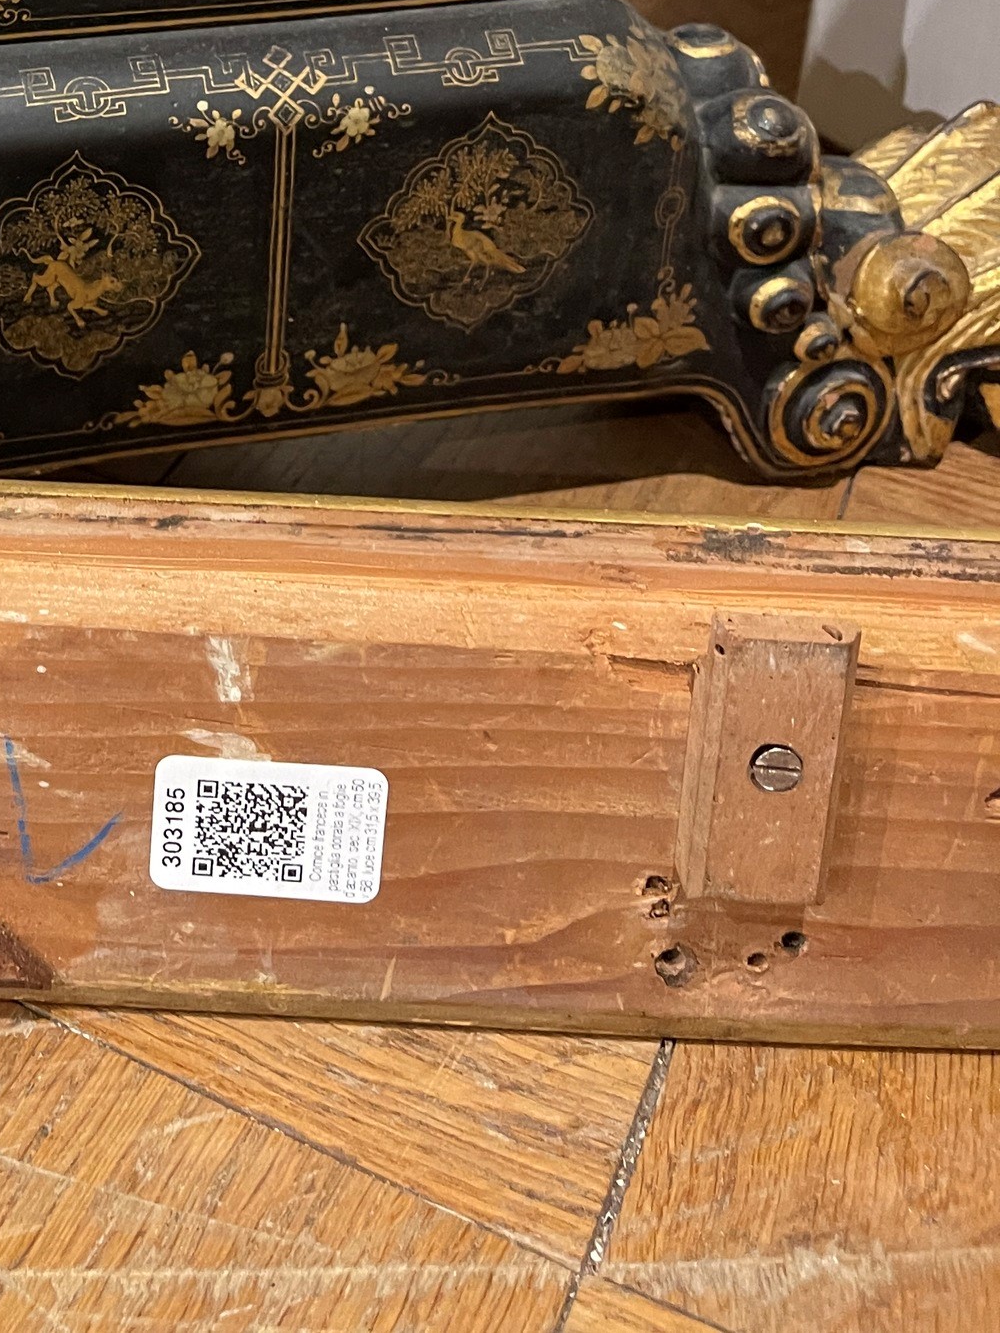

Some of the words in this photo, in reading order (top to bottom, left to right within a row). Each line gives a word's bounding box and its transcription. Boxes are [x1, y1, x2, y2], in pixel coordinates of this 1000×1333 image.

[351, 779, 365, 792] 50
[318, 791, 328, 800] in
[353, 793, 363, 809] cm
[162, 787, 185, 867] 303185
[366, 837, 376, 852] cm
